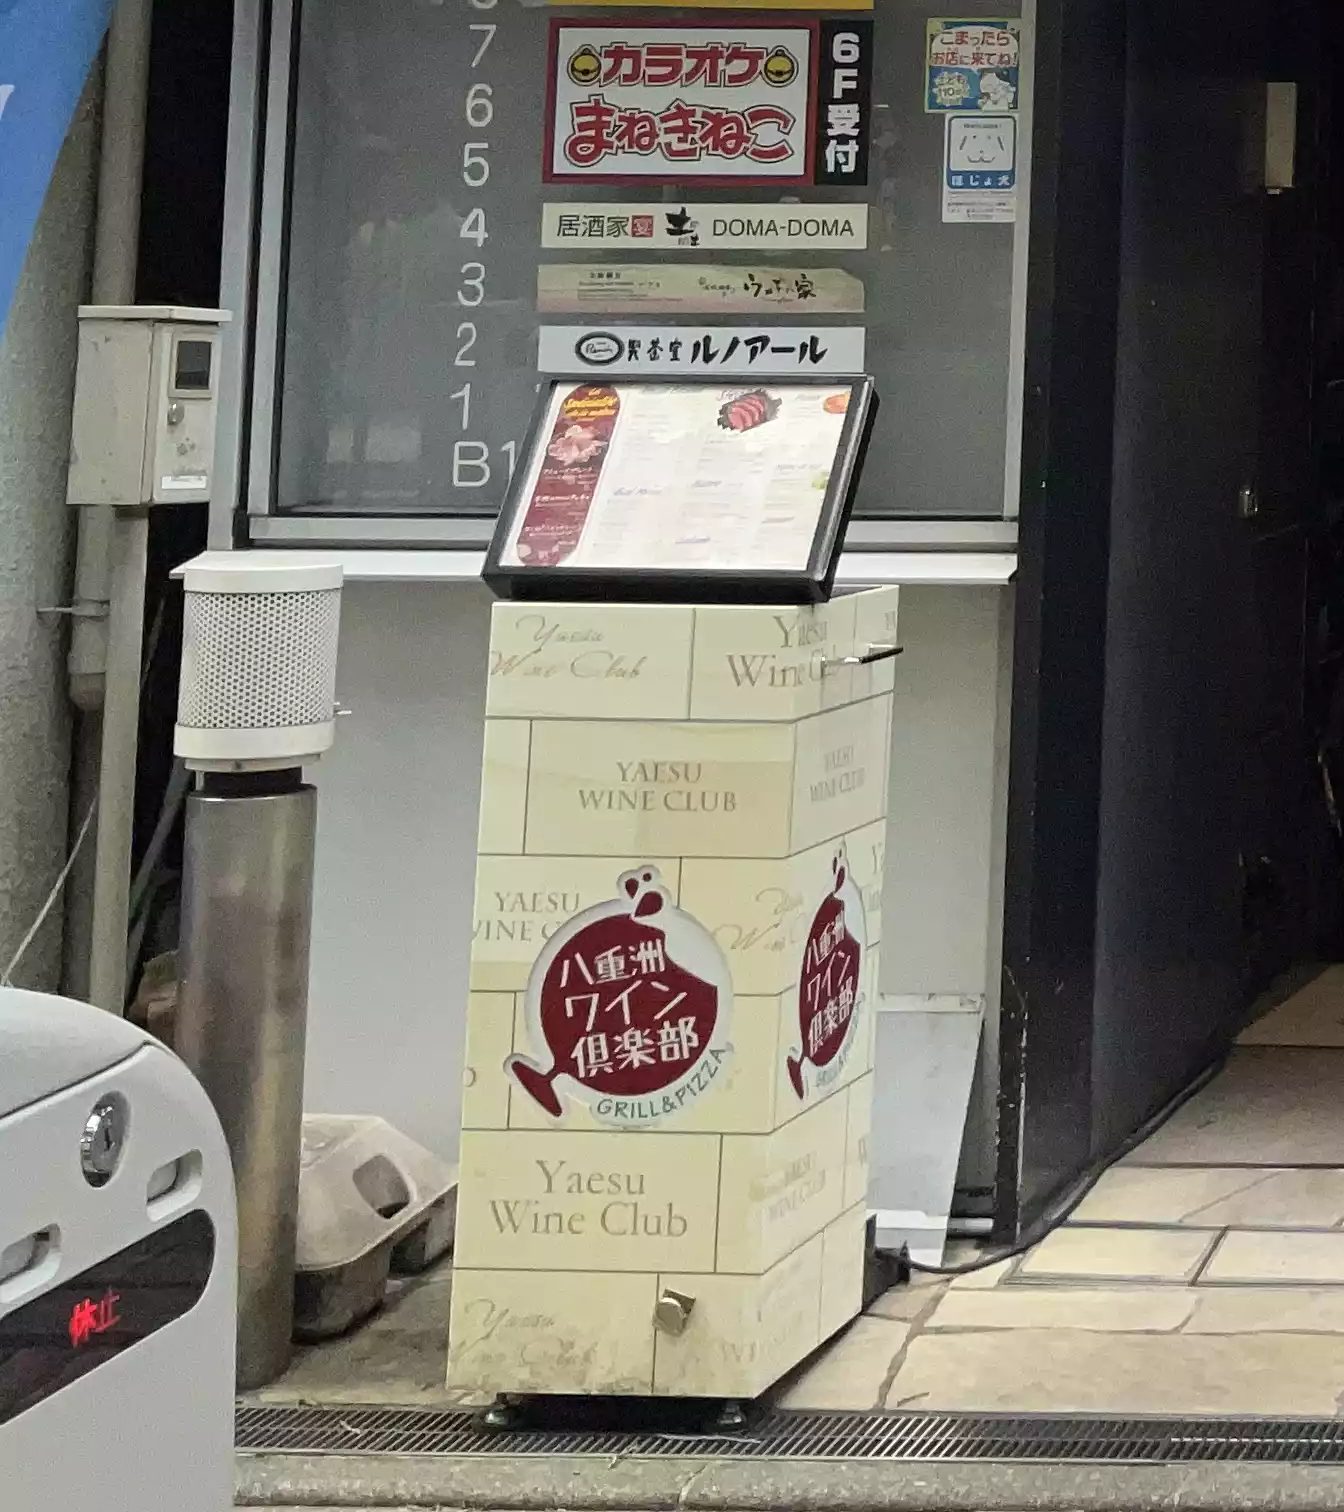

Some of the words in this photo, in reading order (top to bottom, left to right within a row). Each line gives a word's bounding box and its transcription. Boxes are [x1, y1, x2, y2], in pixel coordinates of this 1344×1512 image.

[470, 24, 497, 68] 7
[941, 31, 1010, 46] こまったら
[601, 42, 767, 87] カラオケ
[465, 83, 493, 128] 6
[564, 94, 796, 167] まねきねこ
[463, 143, 489, 187] 5
[459, 207, 488, 248] 4
[713, 219, 854, 237] DOMA-DOMA
[457, 262, 484, 307] 3
[454, 321, 476, 366] 2
[691, 335, 828, 364] ルノアール
[450, 382, 471, 430] 1
[453, 440, 517, 488] B1
[617, 761, 702, 784] YAESU
[579, 789, 656, 811] WINE
[663, 789, 737, 813] CLUB
[494, 892, 580, 912] YAESU
[560, 939, 665, 988] 八重洲
[807, 910, 845, 974] 八重洲
[808, 950, 850, 1010] ワイン
[565, 980, 687, 1032] ワイン
[810, 976, 854, 1057] 倶楽部
[570, 1016, 699, 1078] 倶楽部
[597, 1046, 726, 1119] GRILL&PIZZA
[536, 1160, 645, 1196] Yaesu
[489, 1200, 585, 1235] Wine
[601, 1201, 688, 1238] Club
